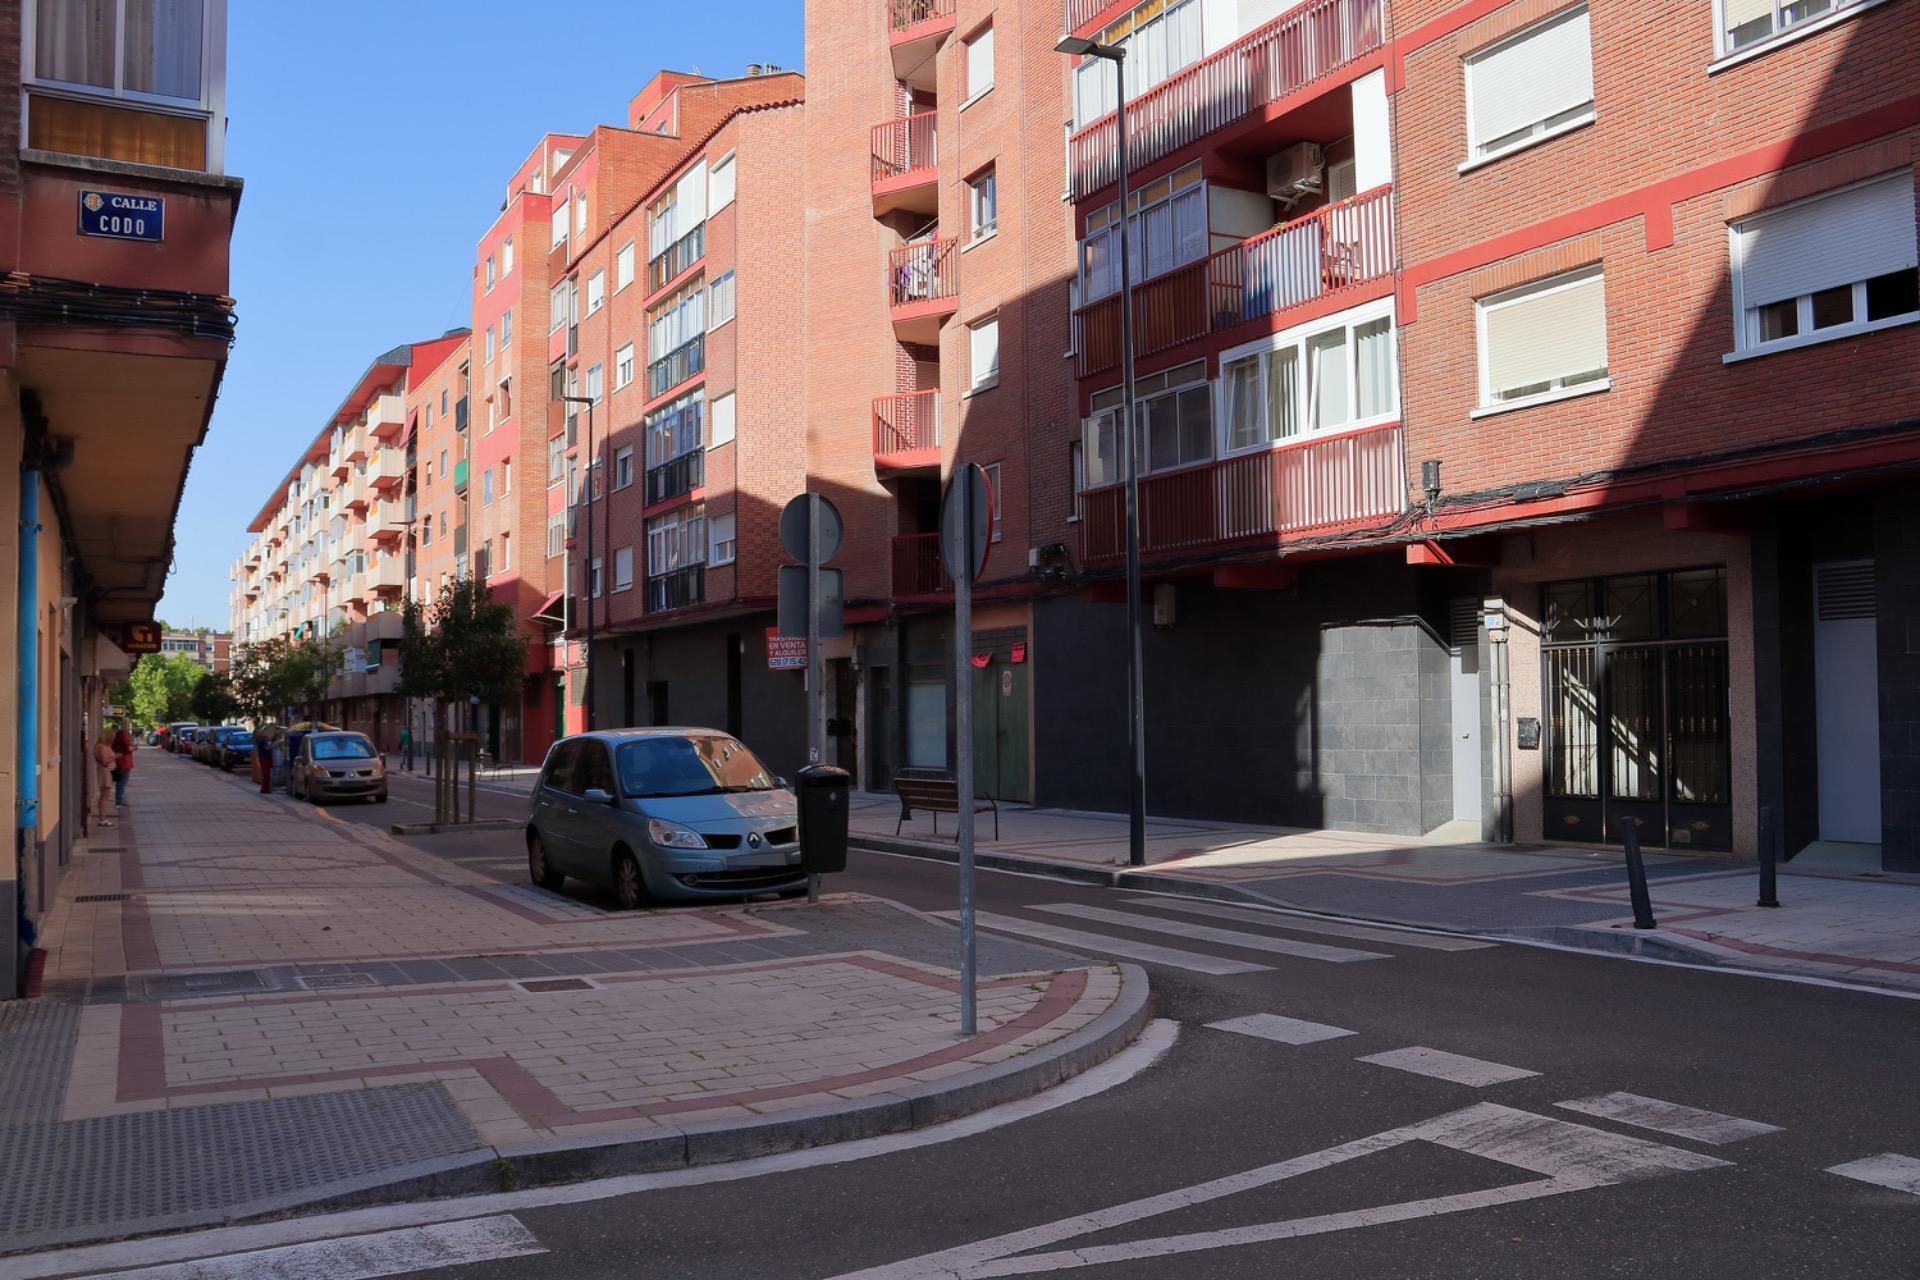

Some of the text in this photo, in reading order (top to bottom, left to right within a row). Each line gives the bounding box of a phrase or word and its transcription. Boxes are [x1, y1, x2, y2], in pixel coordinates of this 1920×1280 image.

[111, 197, 157, 211] CALLE
[100, 215, 144, 235] CODO
[780, 641, 806, 649] VENTA
